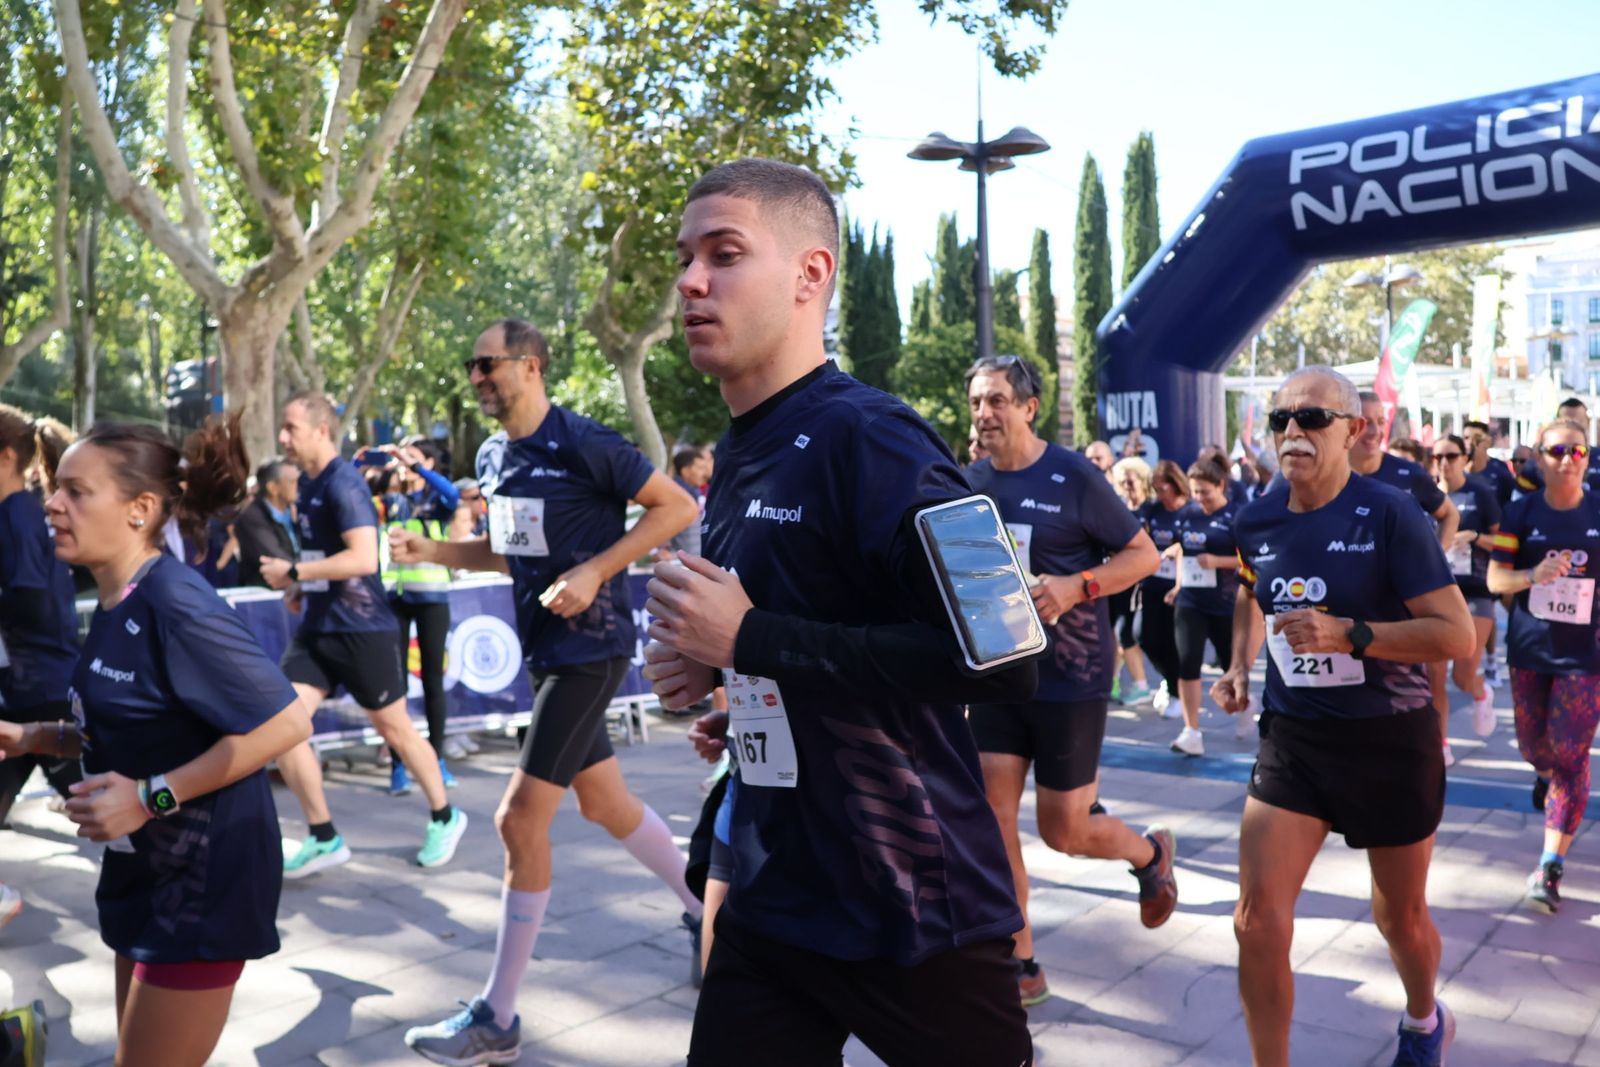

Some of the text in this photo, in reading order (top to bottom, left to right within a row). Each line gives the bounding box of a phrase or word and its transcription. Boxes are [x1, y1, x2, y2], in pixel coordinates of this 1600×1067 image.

[1290, 147, 1600, 231] NACION
[1106, 390, 1159, 430] RUTA
[761, 505, 802, 525] mupol
[504, 531, 530, 547] 205
[1348, 541, 1375, 553] mupol
[1270, 576, 1328, 603] 200
[1547, 601, 1577, 616] 105
[101, 665, 136, 683] mupol
[1292, 656, 1334, 675] 221
[737, 731, 767, 764] 167
